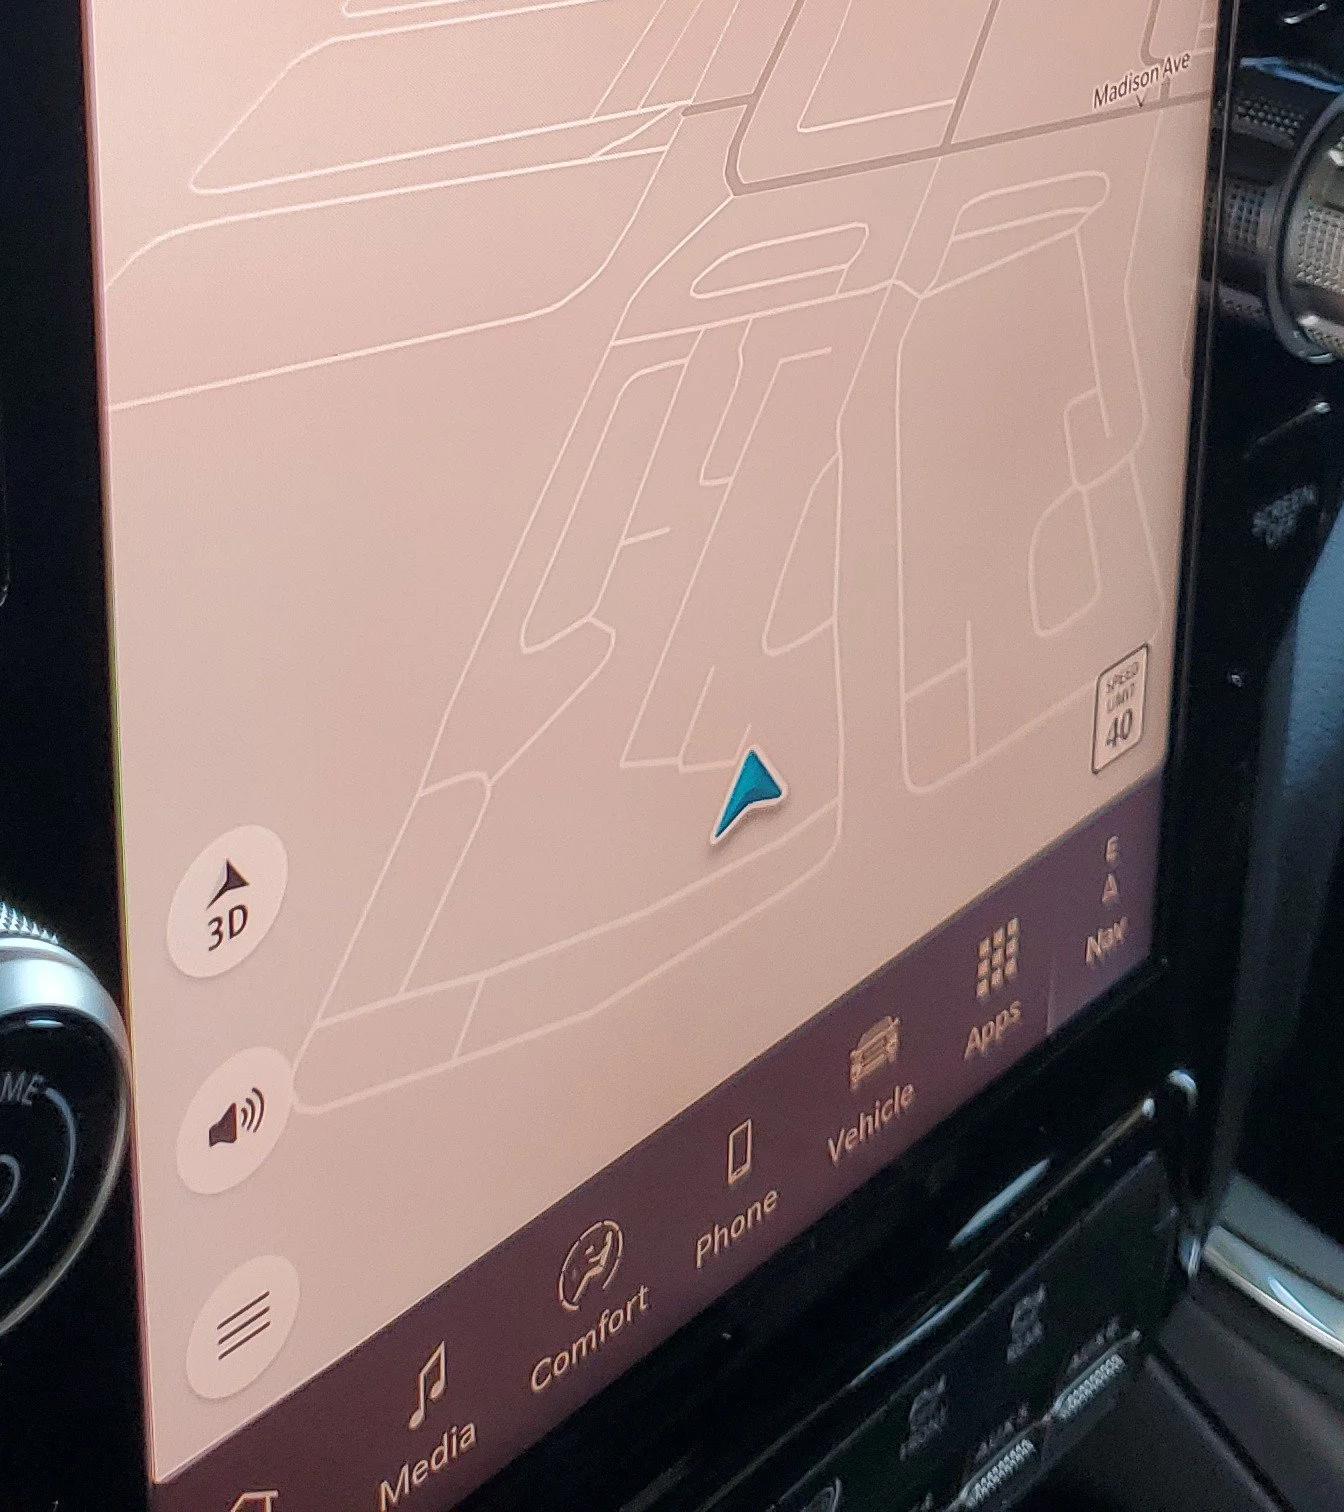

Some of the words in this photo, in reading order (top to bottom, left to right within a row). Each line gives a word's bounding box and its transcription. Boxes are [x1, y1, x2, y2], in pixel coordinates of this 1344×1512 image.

[1093, 66, 1159, 109] Madison
[1162, 52, 1191, 78] Ave
[1104, 707, 1134, 748] 40
[207, 904, 249, 952] 3D
[1085, 915, 1130, 969] Nav
[963, 1000, 1023, 1062] Apps
[827, 1082, 915, 1168] Vehicle
[695, 1188, 779, 1269] Phone
[529, 1284, 651, 1394] Comfort
[378, 1420, 478, 1512] Media
